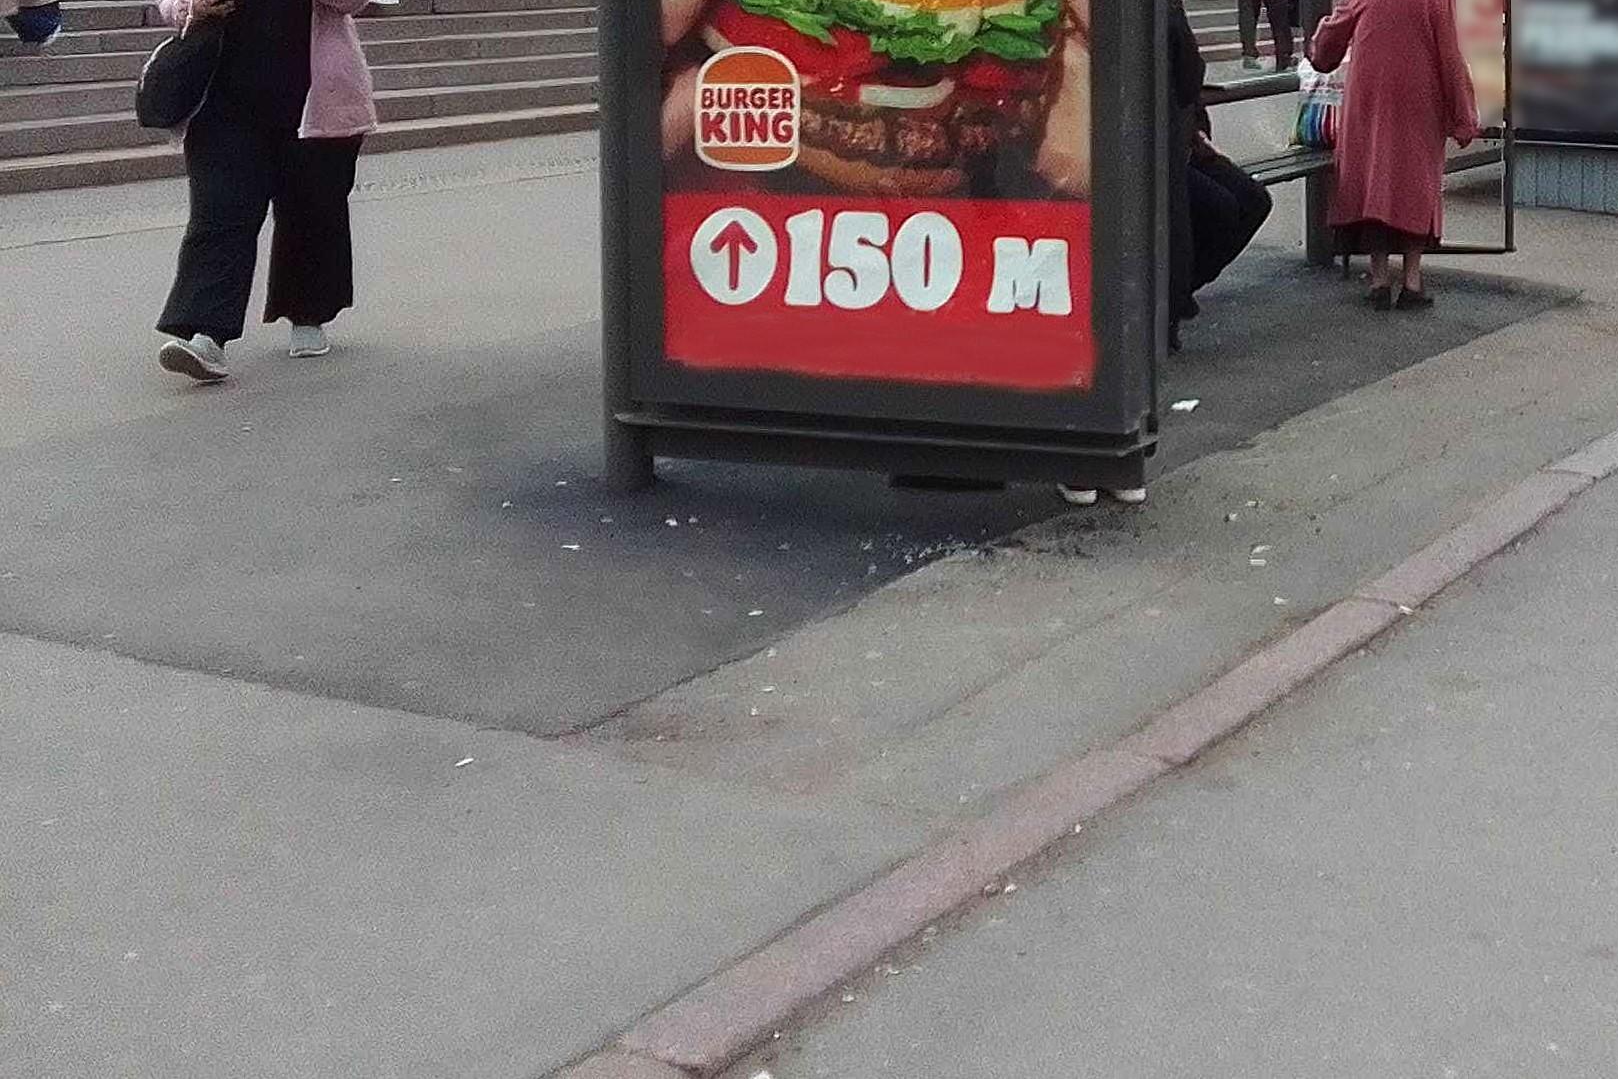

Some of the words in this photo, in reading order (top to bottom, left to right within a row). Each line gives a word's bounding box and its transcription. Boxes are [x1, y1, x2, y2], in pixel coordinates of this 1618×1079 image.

[701, 87, 794, 111] BURGER
[700, 110, 794, 145] KING
[784, 208, 963, 311] 150
